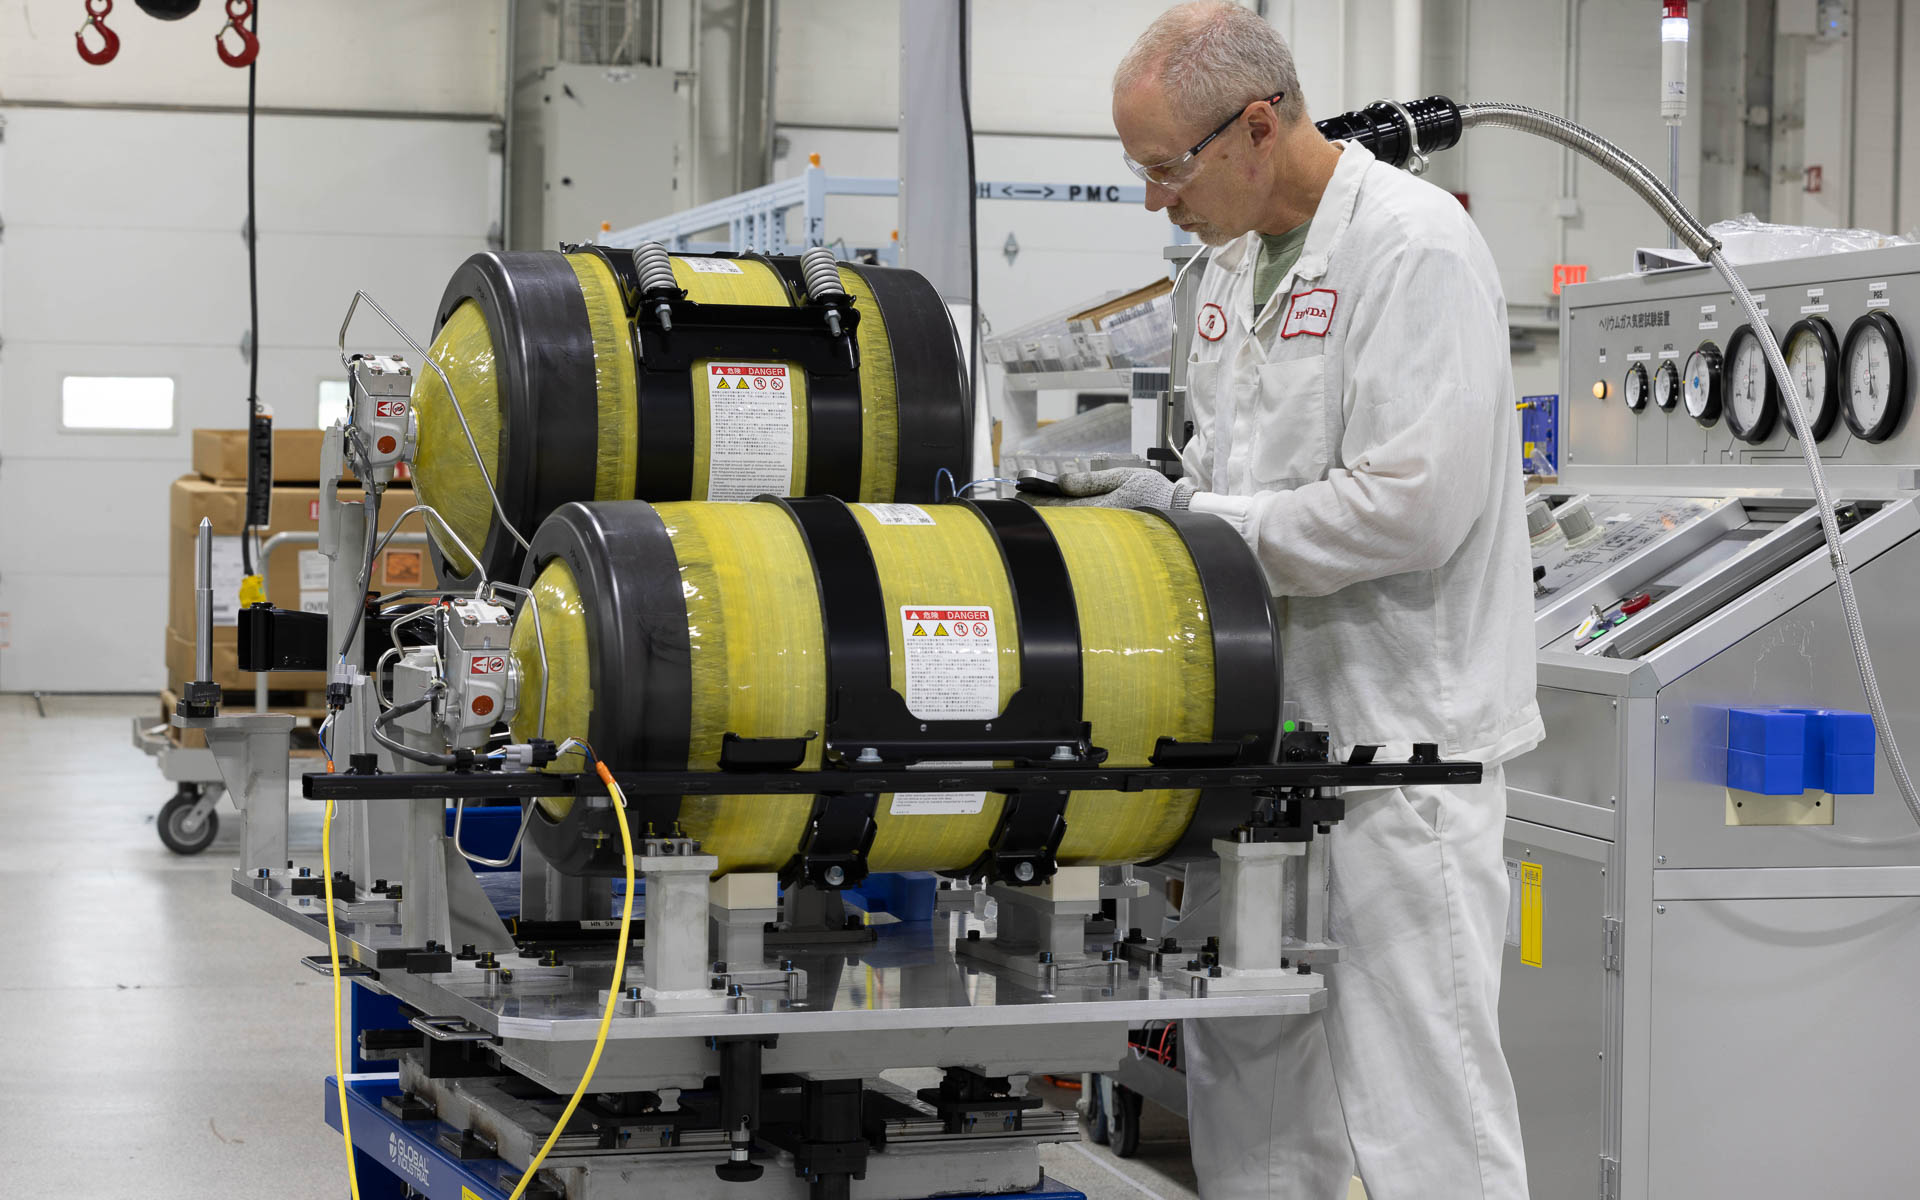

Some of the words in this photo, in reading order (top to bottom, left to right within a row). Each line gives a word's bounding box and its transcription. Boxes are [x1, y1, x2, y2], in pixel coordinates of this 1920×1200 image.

[1069, 185, 1120, 202] PMC
[1873, 290, 1883, 299] PG5
[947, 611, 987, 620] DANGER
[397, 1138, 429, 1174] GLOBAL
[397, 1154, 430, 1187] INDUSTRIAL
